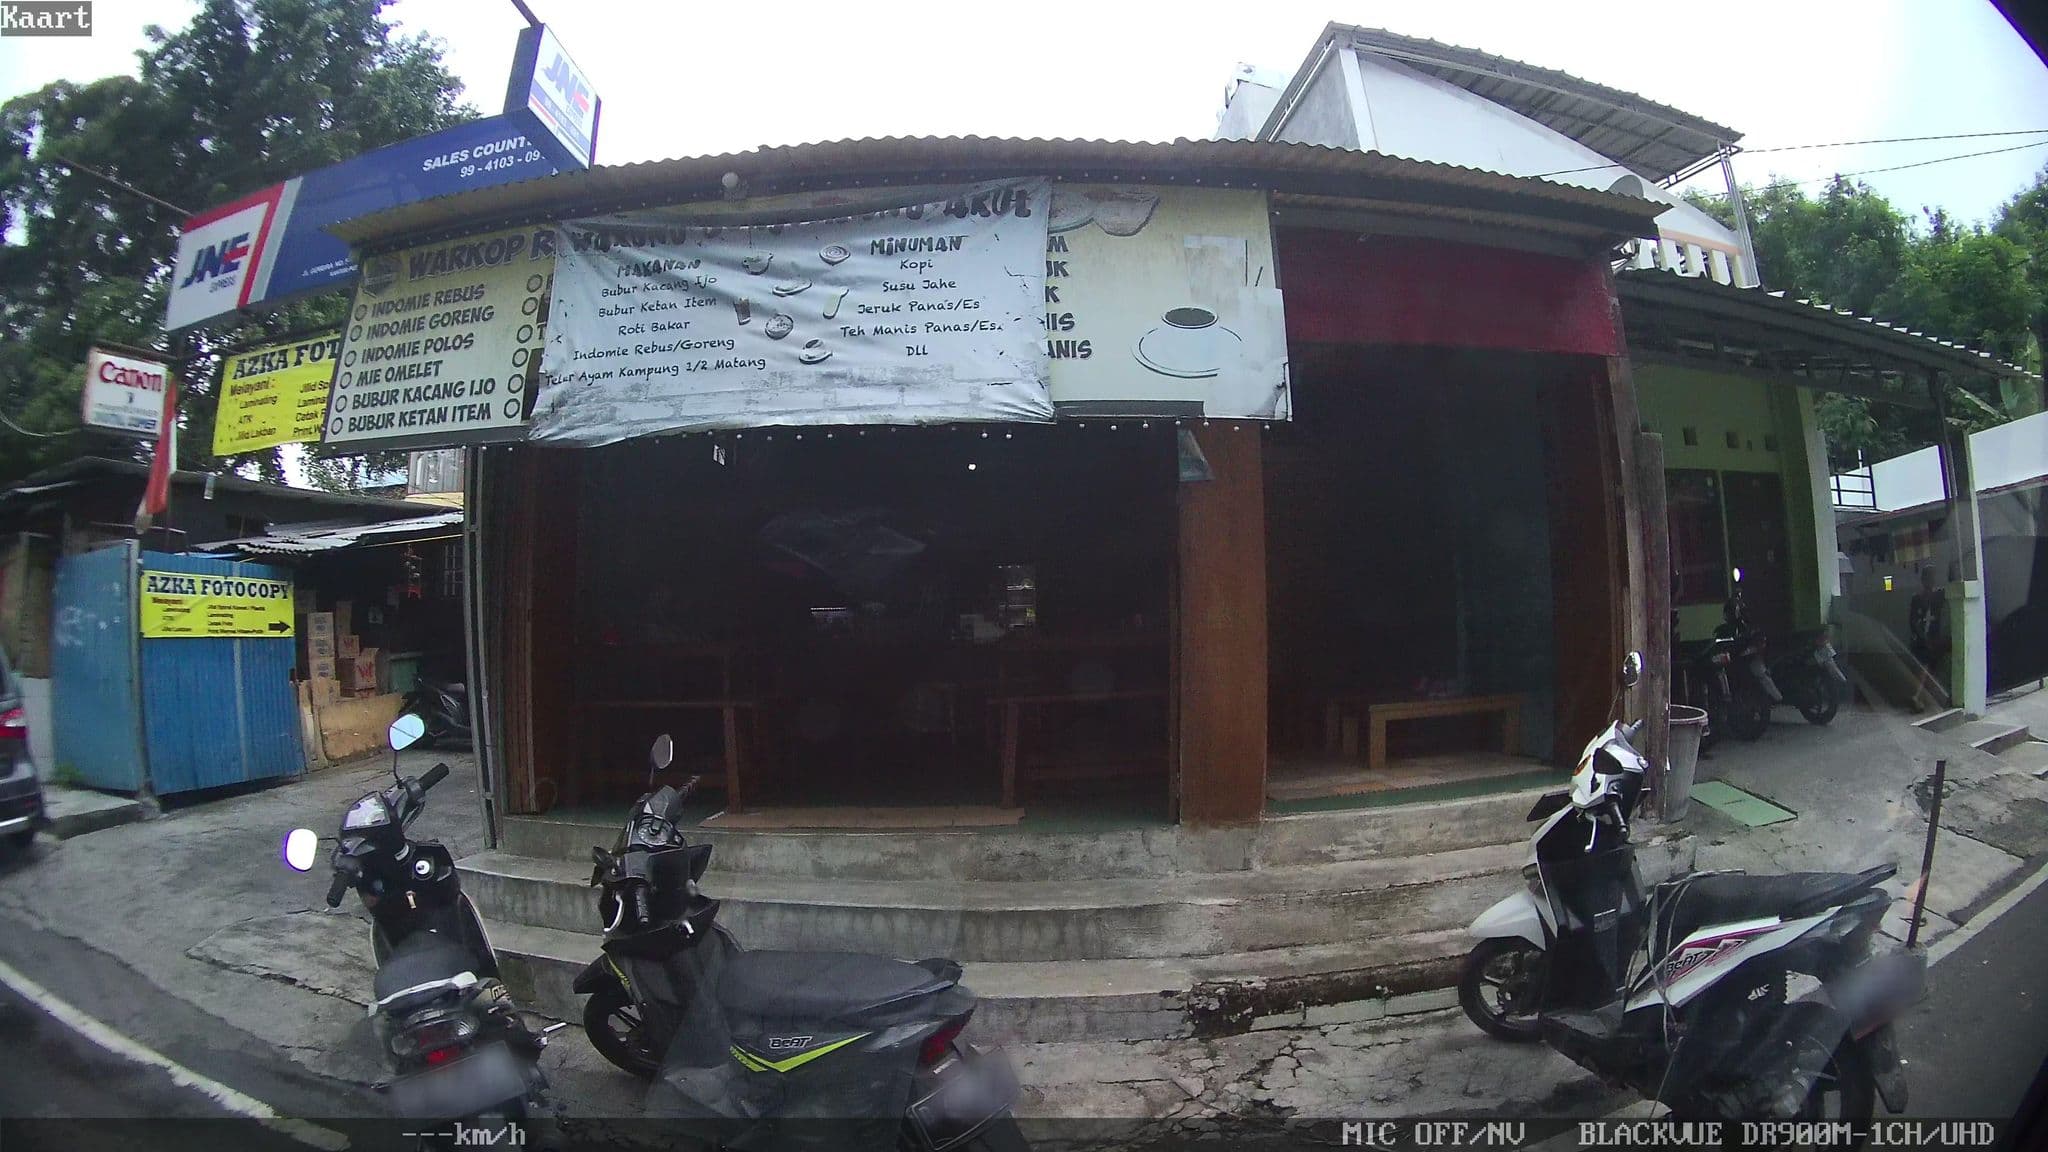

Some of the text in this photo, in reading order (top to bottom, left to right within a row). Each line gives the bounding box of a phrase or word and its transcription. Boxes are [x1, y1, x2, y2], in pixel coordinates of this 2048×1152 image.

[542, 53, 590, 113] JNE
[422, 136, 532, 172] SALES COUNT
[460, 165, 475, 178] 99
[485, 156, 514, 172] 4103
[180, 232, 250, 289] JNE
[408, 233, 526, 282] WARKOP
[616, 258, 702, 278] MAKANAN
[900, 258, 933, 275] Kopi
[601, 275, 718, 298] Bubur Kacang Ijo
[882, 278, 957, 292] Susu Jahe
[371, 283, 486, 319] INDOMIE REBUS
[598, 297, 717, 318] Bubur Ketan Item
[857, 298, 981, 314] Jeruk Panas/Es
[366, 305, 495, 341] INDOMIE GORENG
[618, 319, 691, 336] Roti Bakar
[840, 326, 866, 338] Teh
[873, 324, 917, 336] Manis
[361, 332, 474, 364] INDOMIE POLOS
[573, 337, 735, 361] Indomie Rebus/Goreng
[906, 344, 929, 357] DLL
[99, 361, 162, 392] Canon
[232, 349, 289, 380] AZKA
[356, 360, 444, 387] MIE OMELET
[578, 370, 613, 387] Ayam
[619, 365, 679, 381] Kampung
[685, 360, 708, 372] 1/2
[714, 357, 766, 371] Matang
[352, 377, 496, 410] BUBUR KACANG IJO
[348, 402, 492, 433] BUBUR KETAN ITEM
[146, 575, 289, 600] AZKA FOTOCOPY
